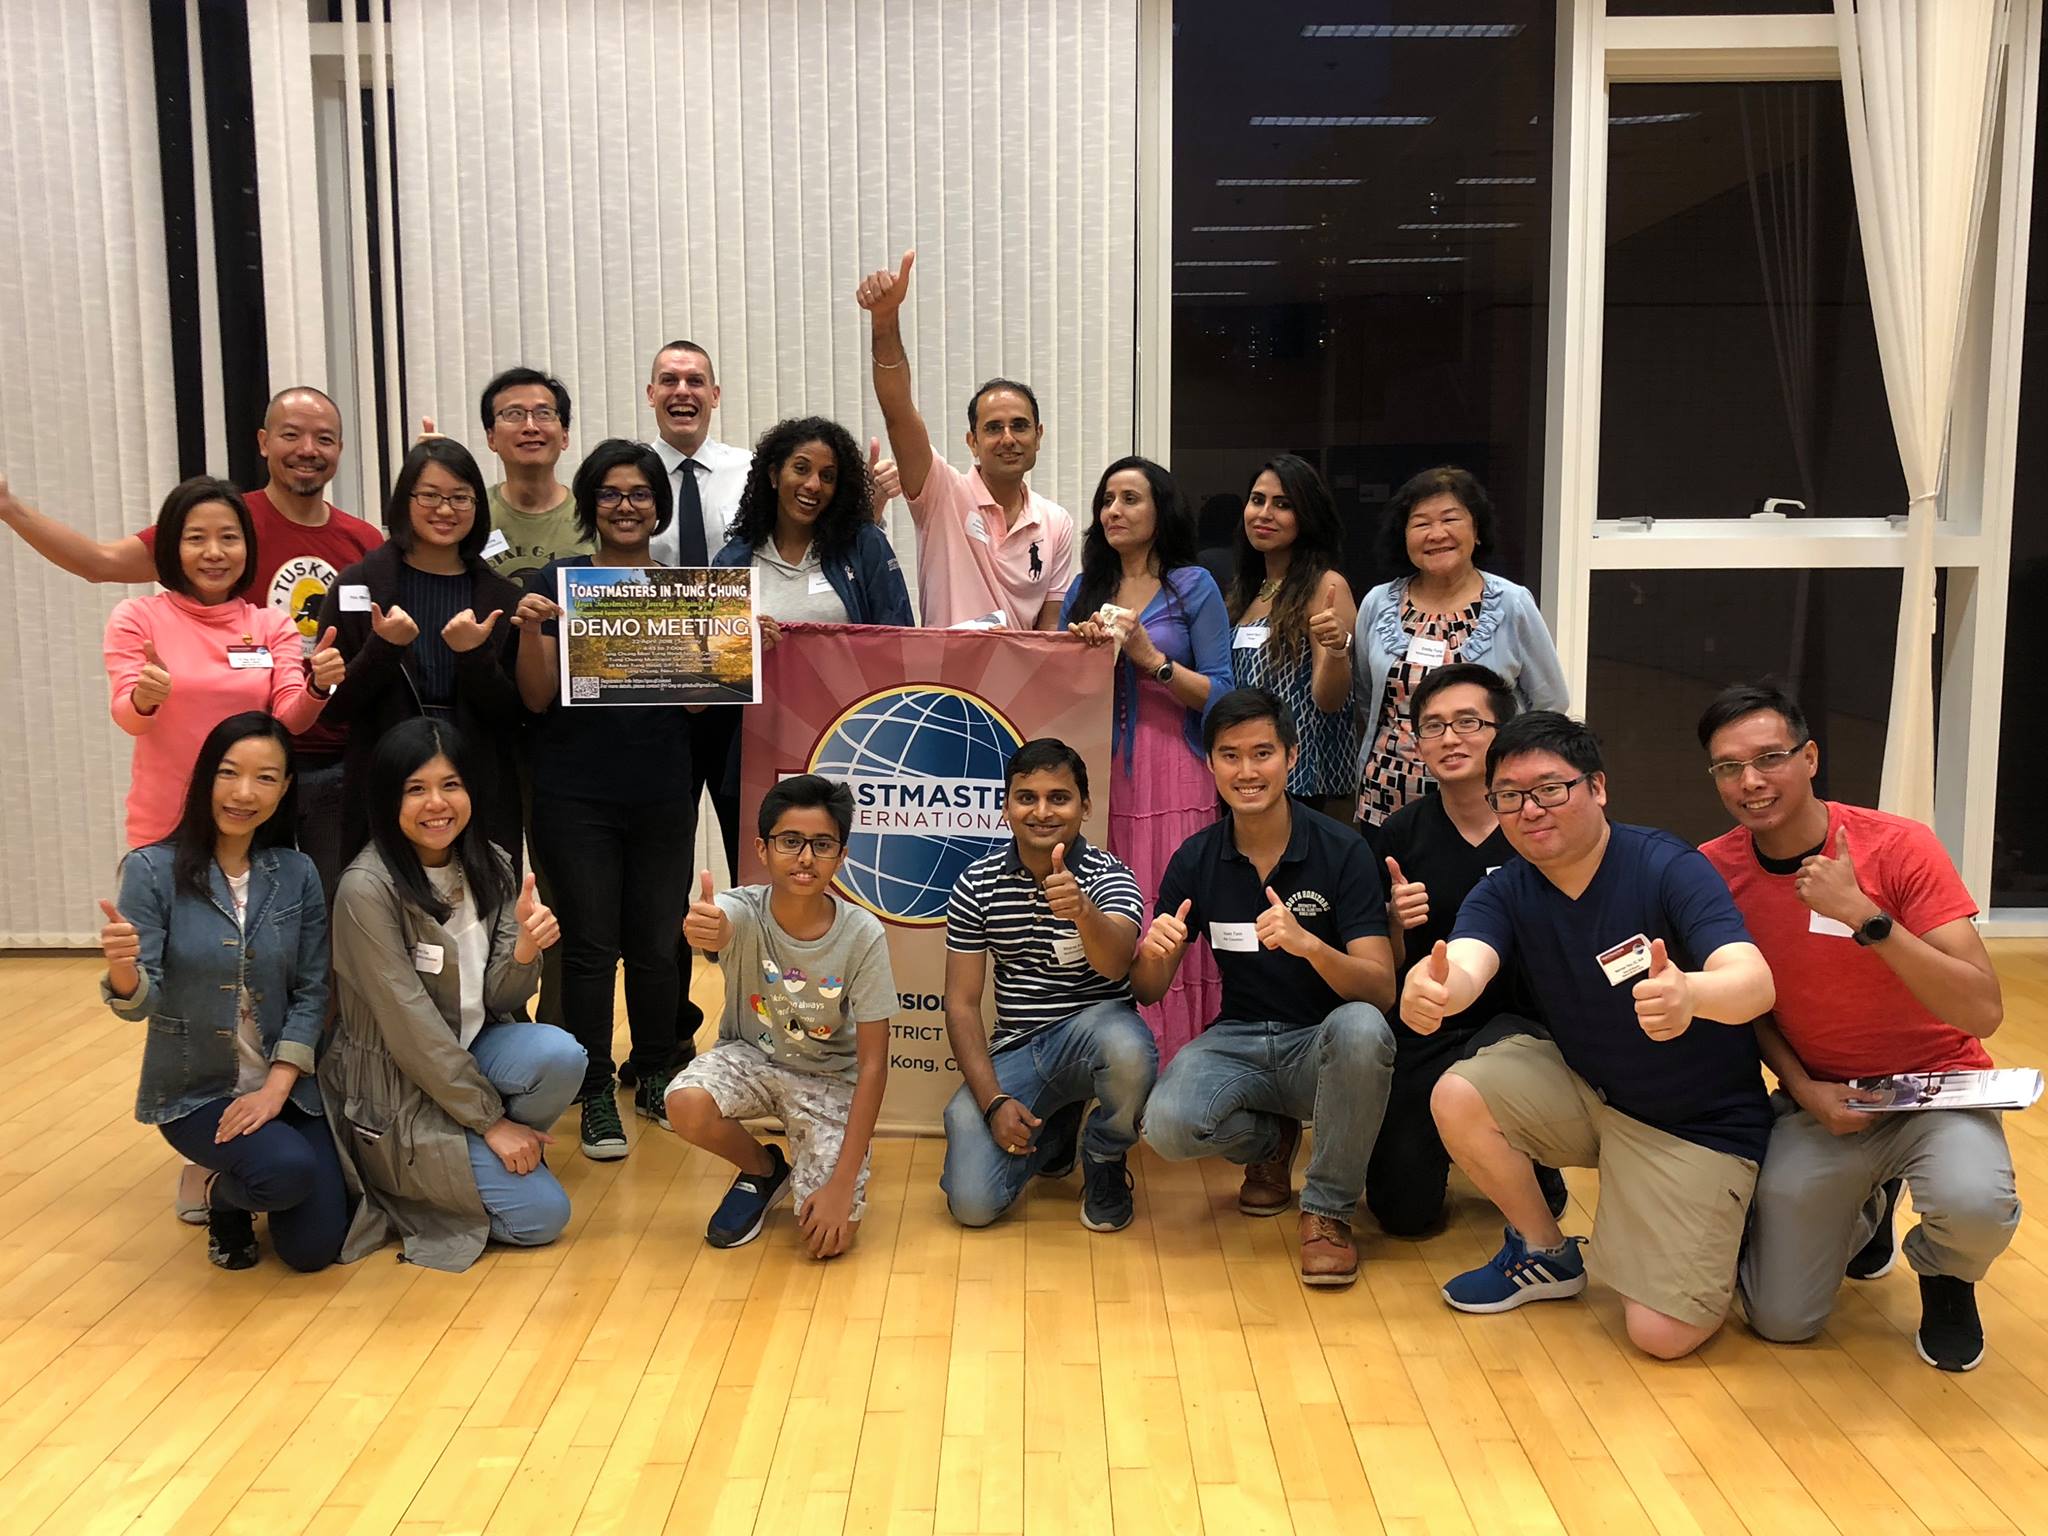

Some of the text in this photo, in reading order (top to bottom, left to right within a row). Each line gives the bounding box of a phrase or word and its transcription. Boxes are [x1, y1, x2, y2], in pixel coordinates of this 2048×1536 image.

[569, 583, 748, 598] TOASTMASTERS IN TUNG CHUNG
[570, 618, 749, 637] DEMO MEETING
[888, 1025, 943, 1041] TRICT
[890, 1054, 961, 1073] Kong, C
